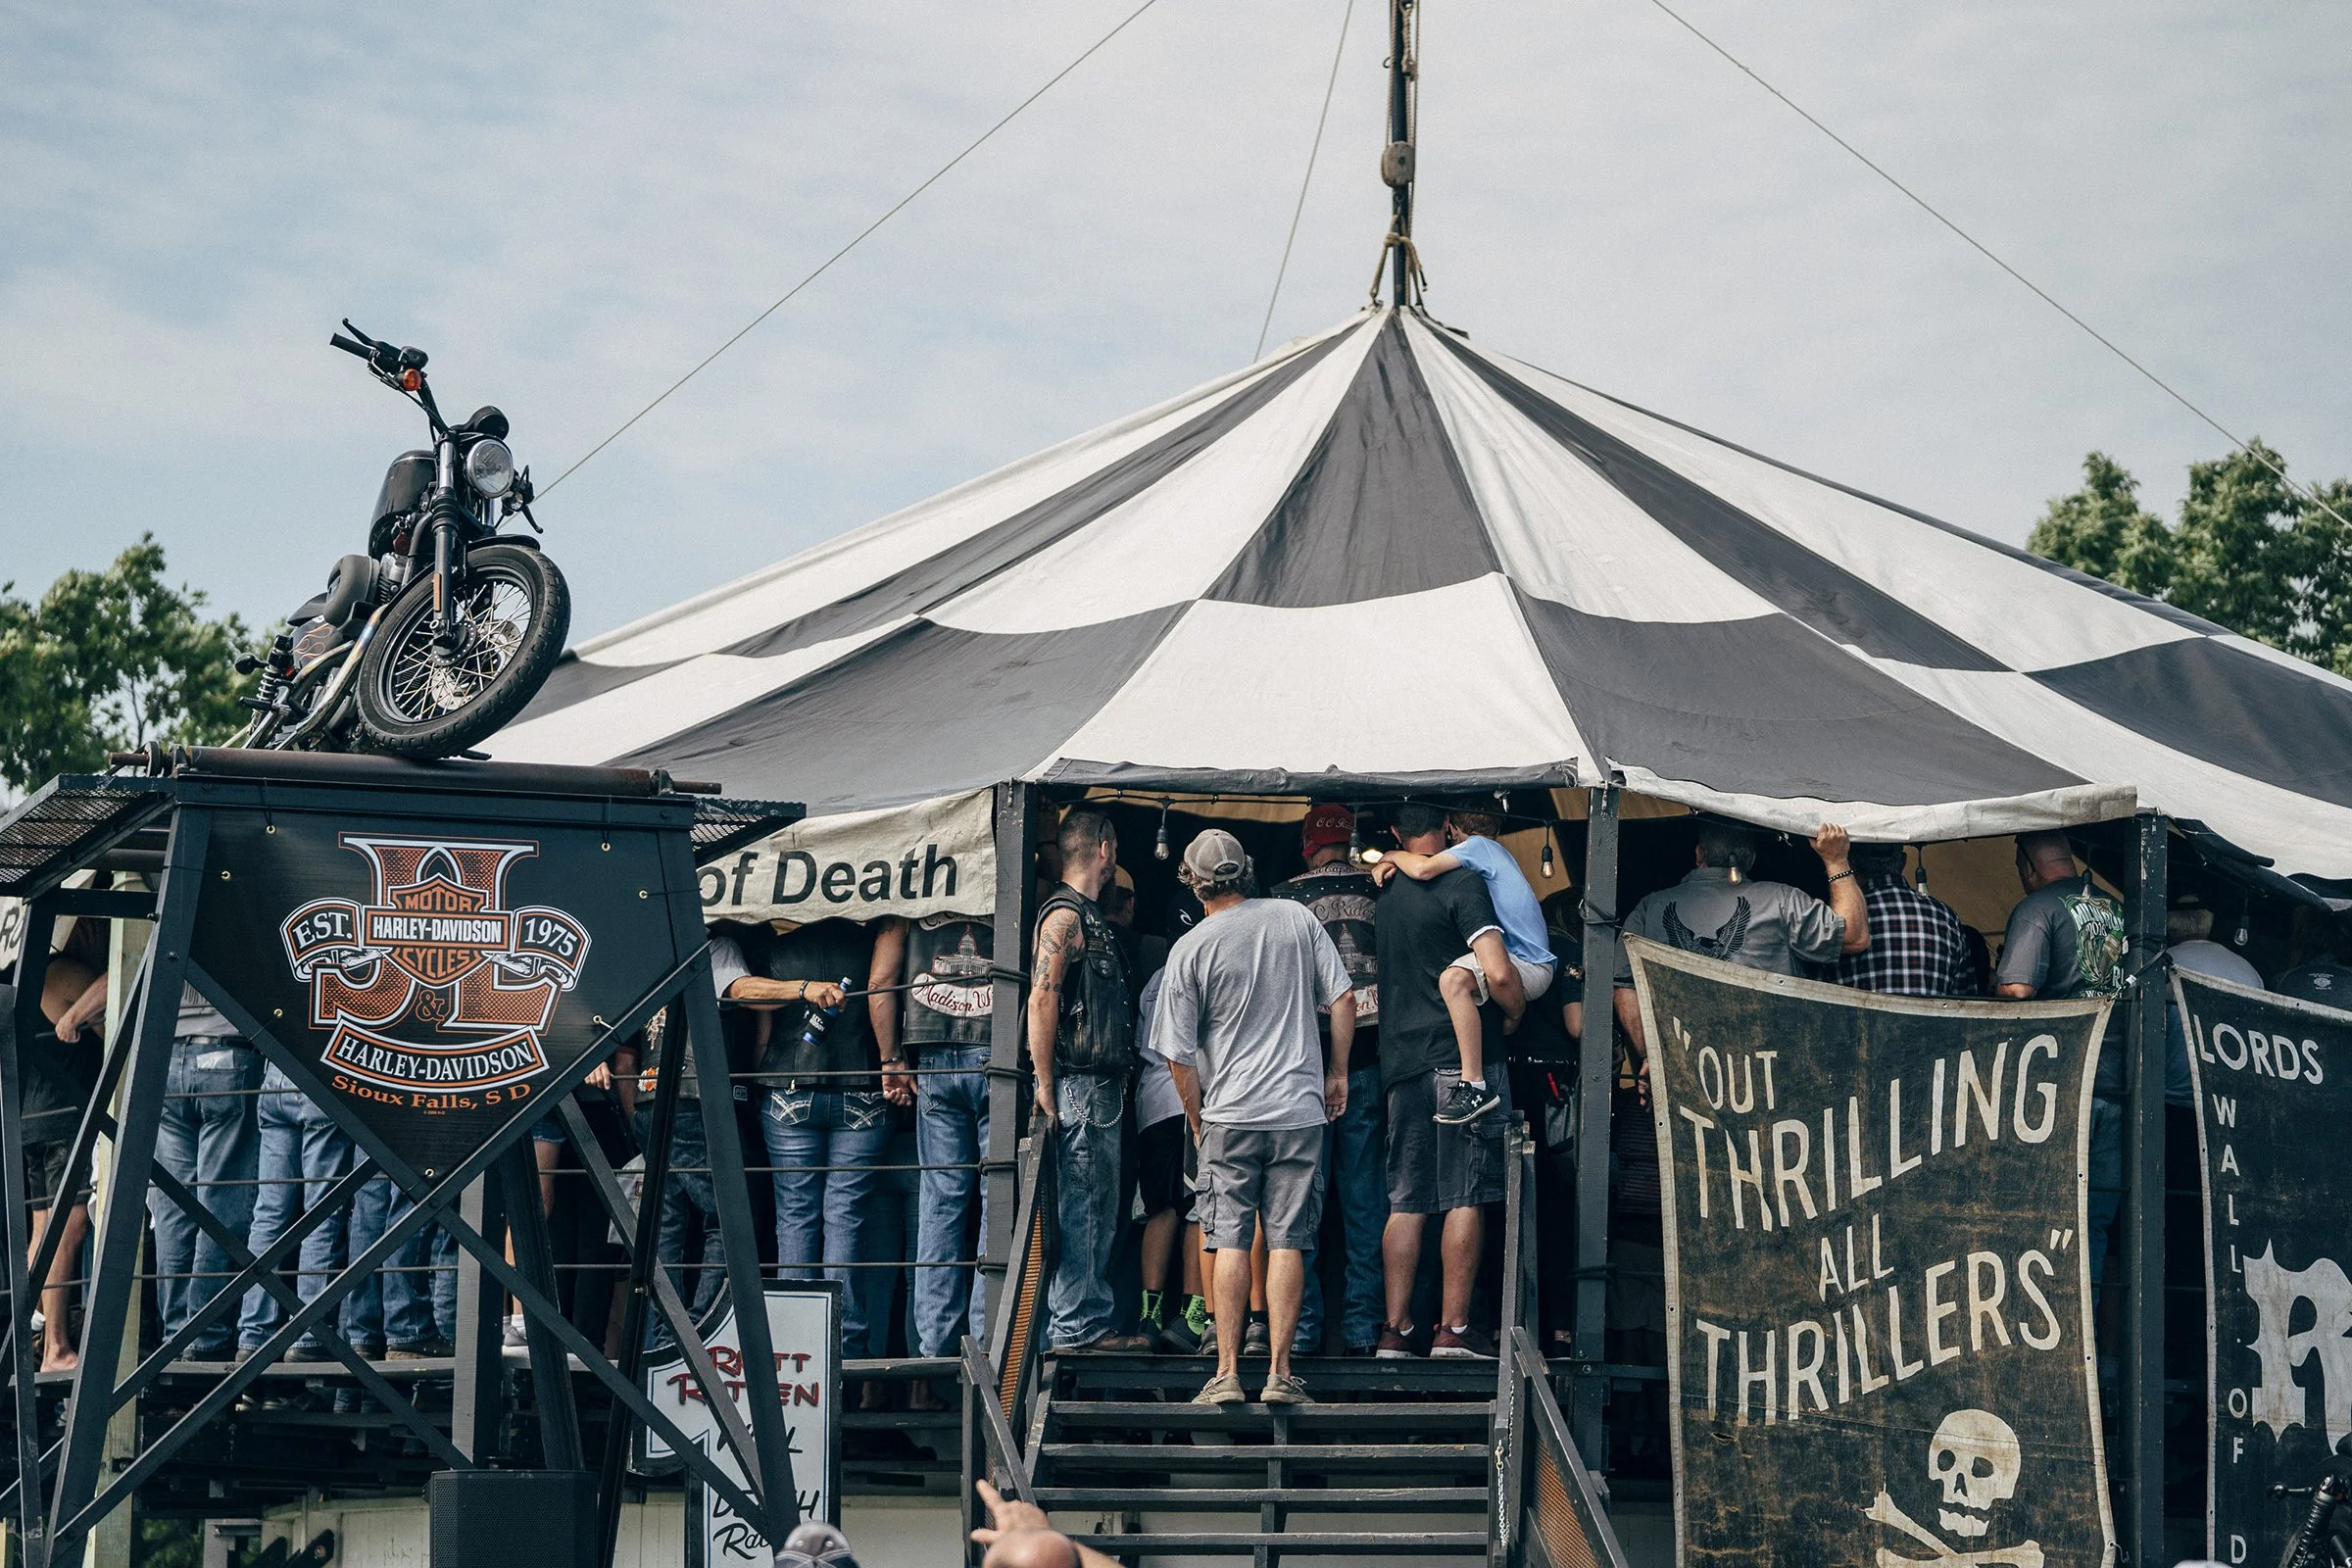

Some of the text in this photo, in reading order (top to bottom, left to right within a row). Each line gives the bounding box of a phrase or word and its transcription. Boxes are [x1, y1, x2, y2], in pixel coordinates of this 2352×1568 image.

[697, 844, 958, 907] of Death
[405, 890, 474, 911] MOTOR
[292, 911, 353, 950] EST.
[372, 915, 502, 944] HARLEY-DAVIDSON
[524, 917, 577, 957] 1975
[406, 948, 470, 979] CYCLES
[2193, 1013, 2324, 1085] LORDS
[331, 1074, 404, 1105] Sioux
[412, 1092, 478, 1110] Falls,
[1679, 1033, 2058, 1232] THRILLING
[1819, 1213, 1894, 1301] ALL
